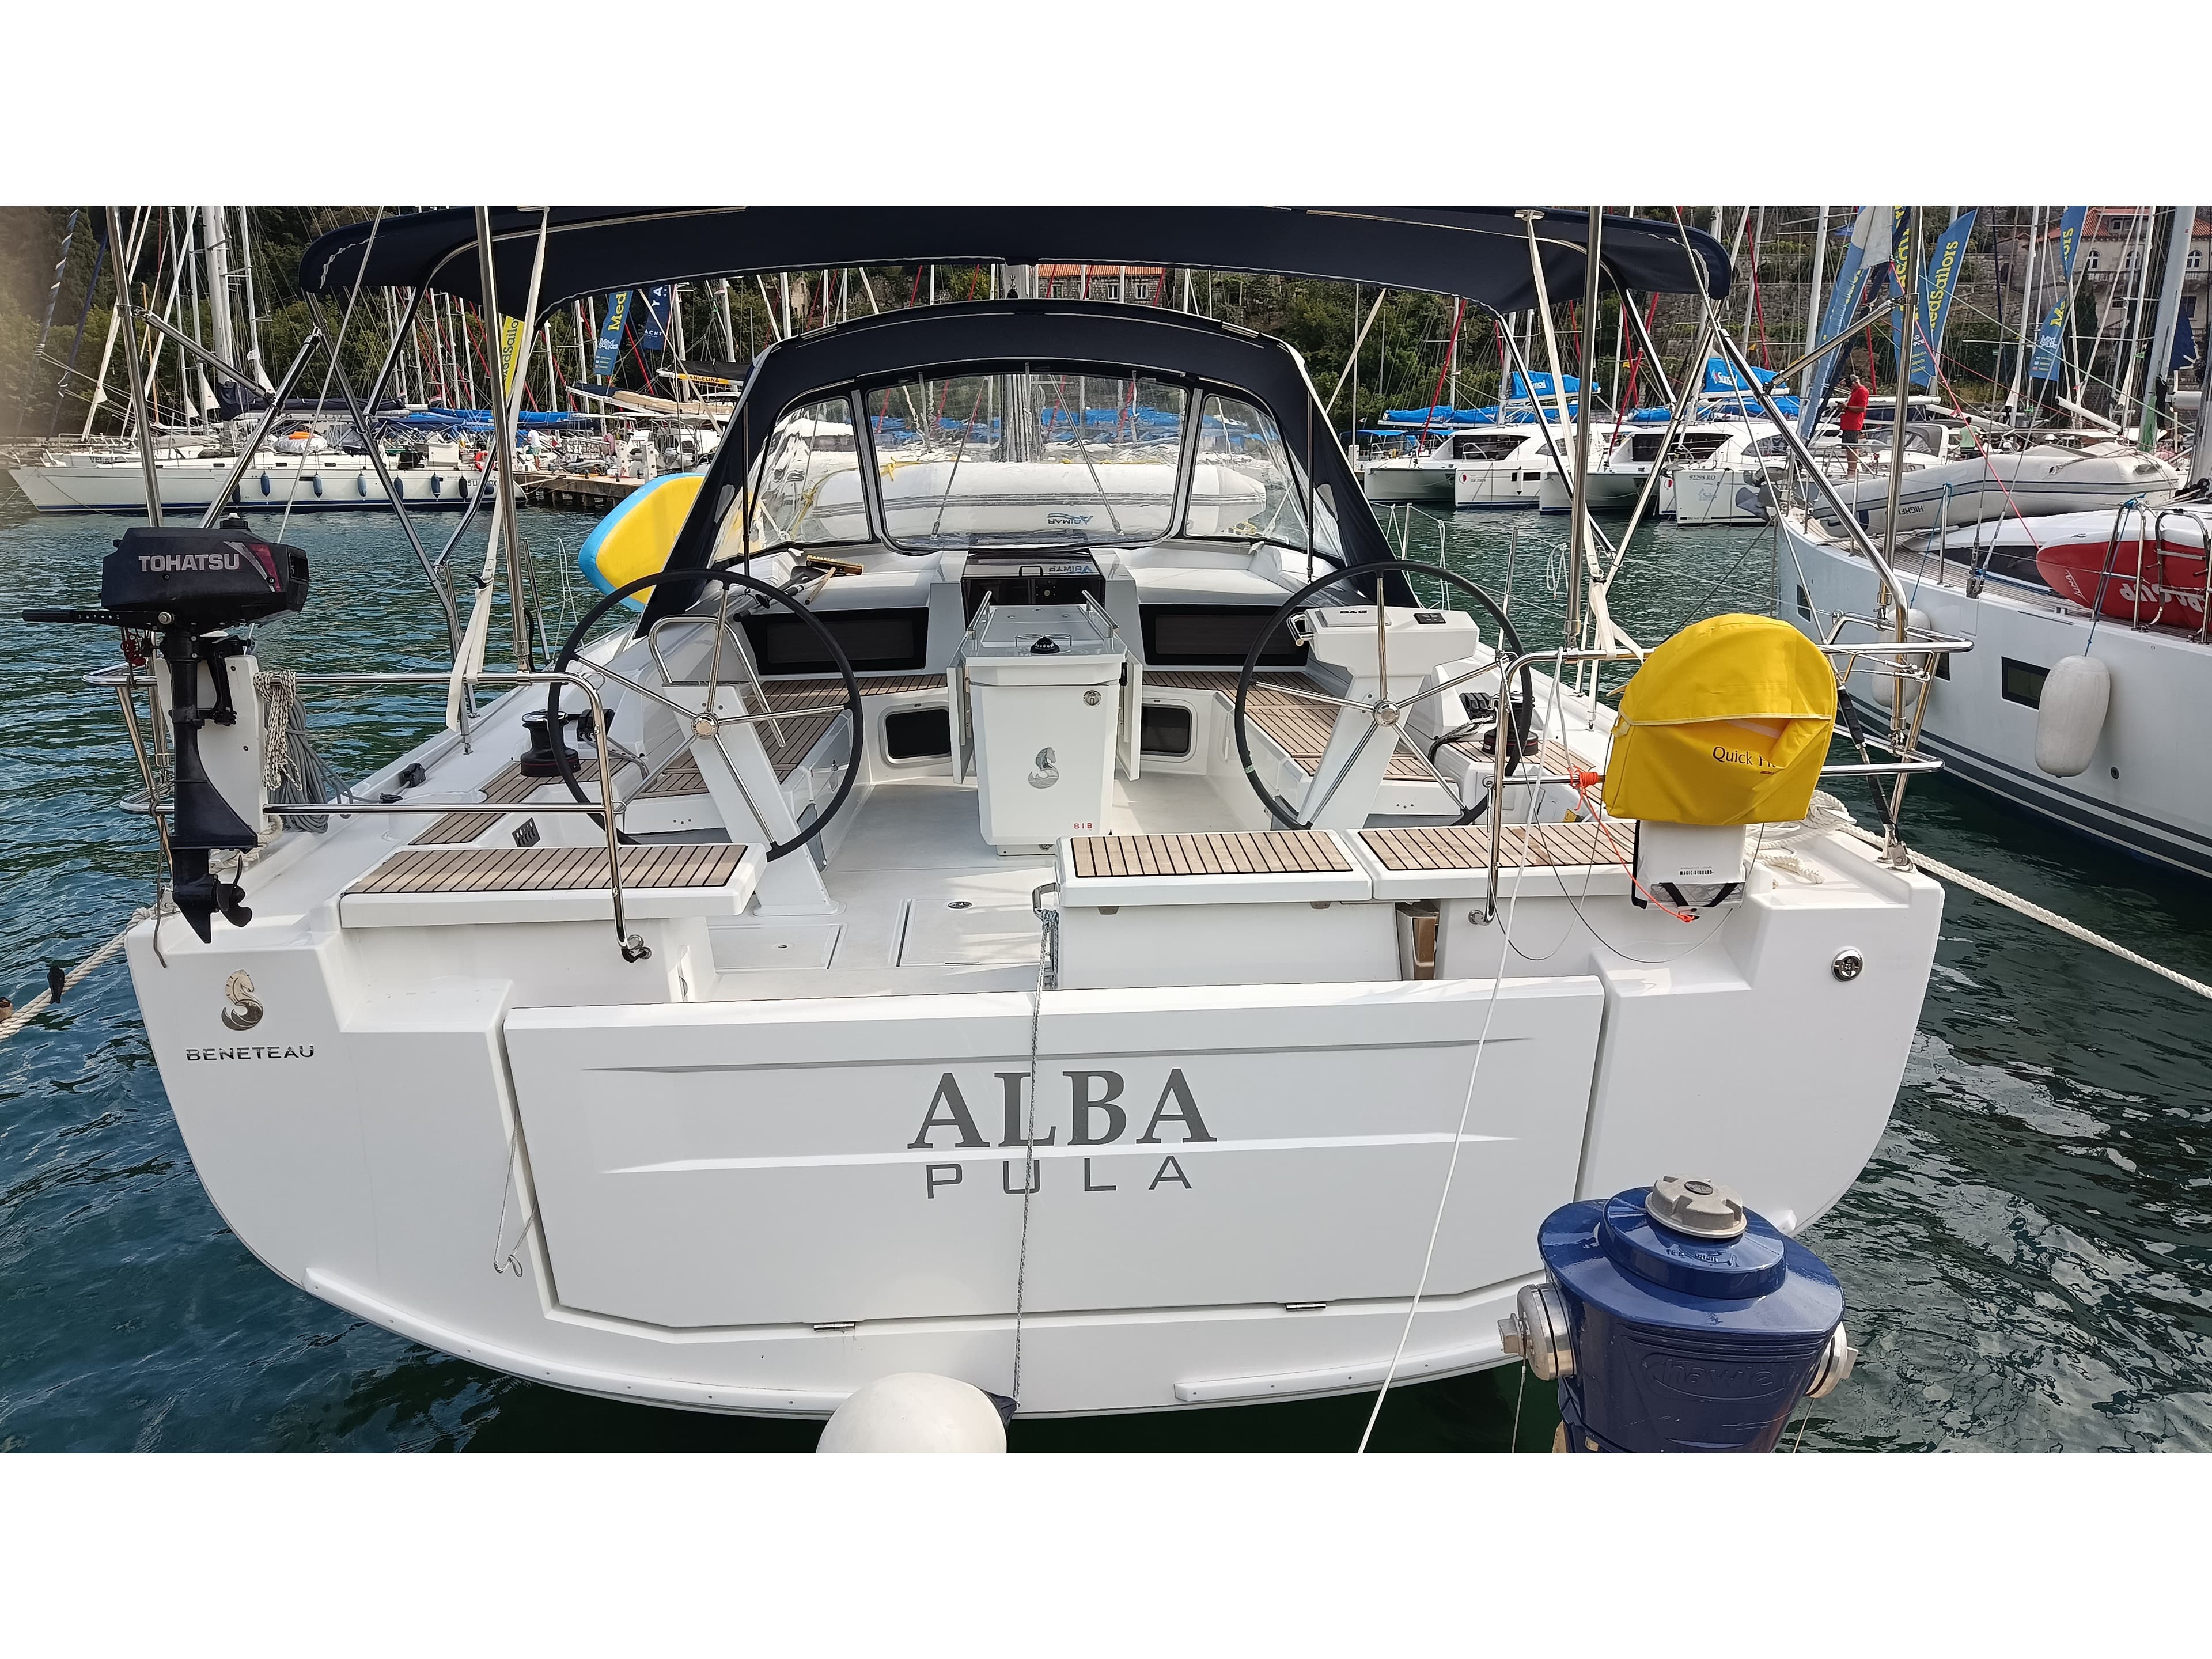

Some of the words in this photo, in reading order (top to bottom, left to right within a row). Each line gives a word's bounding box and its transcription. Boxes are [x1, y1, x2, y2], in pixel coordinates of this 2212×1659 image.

[138, 554, 239, 572] TOHATSU
[1713, 746, 1753, 766] Quick
[185, 1045, 314, 1061] BENETEAU
[907, 1068, 1217, 1149] ALBA
[926, 1155, 1192, 1199] PULA
